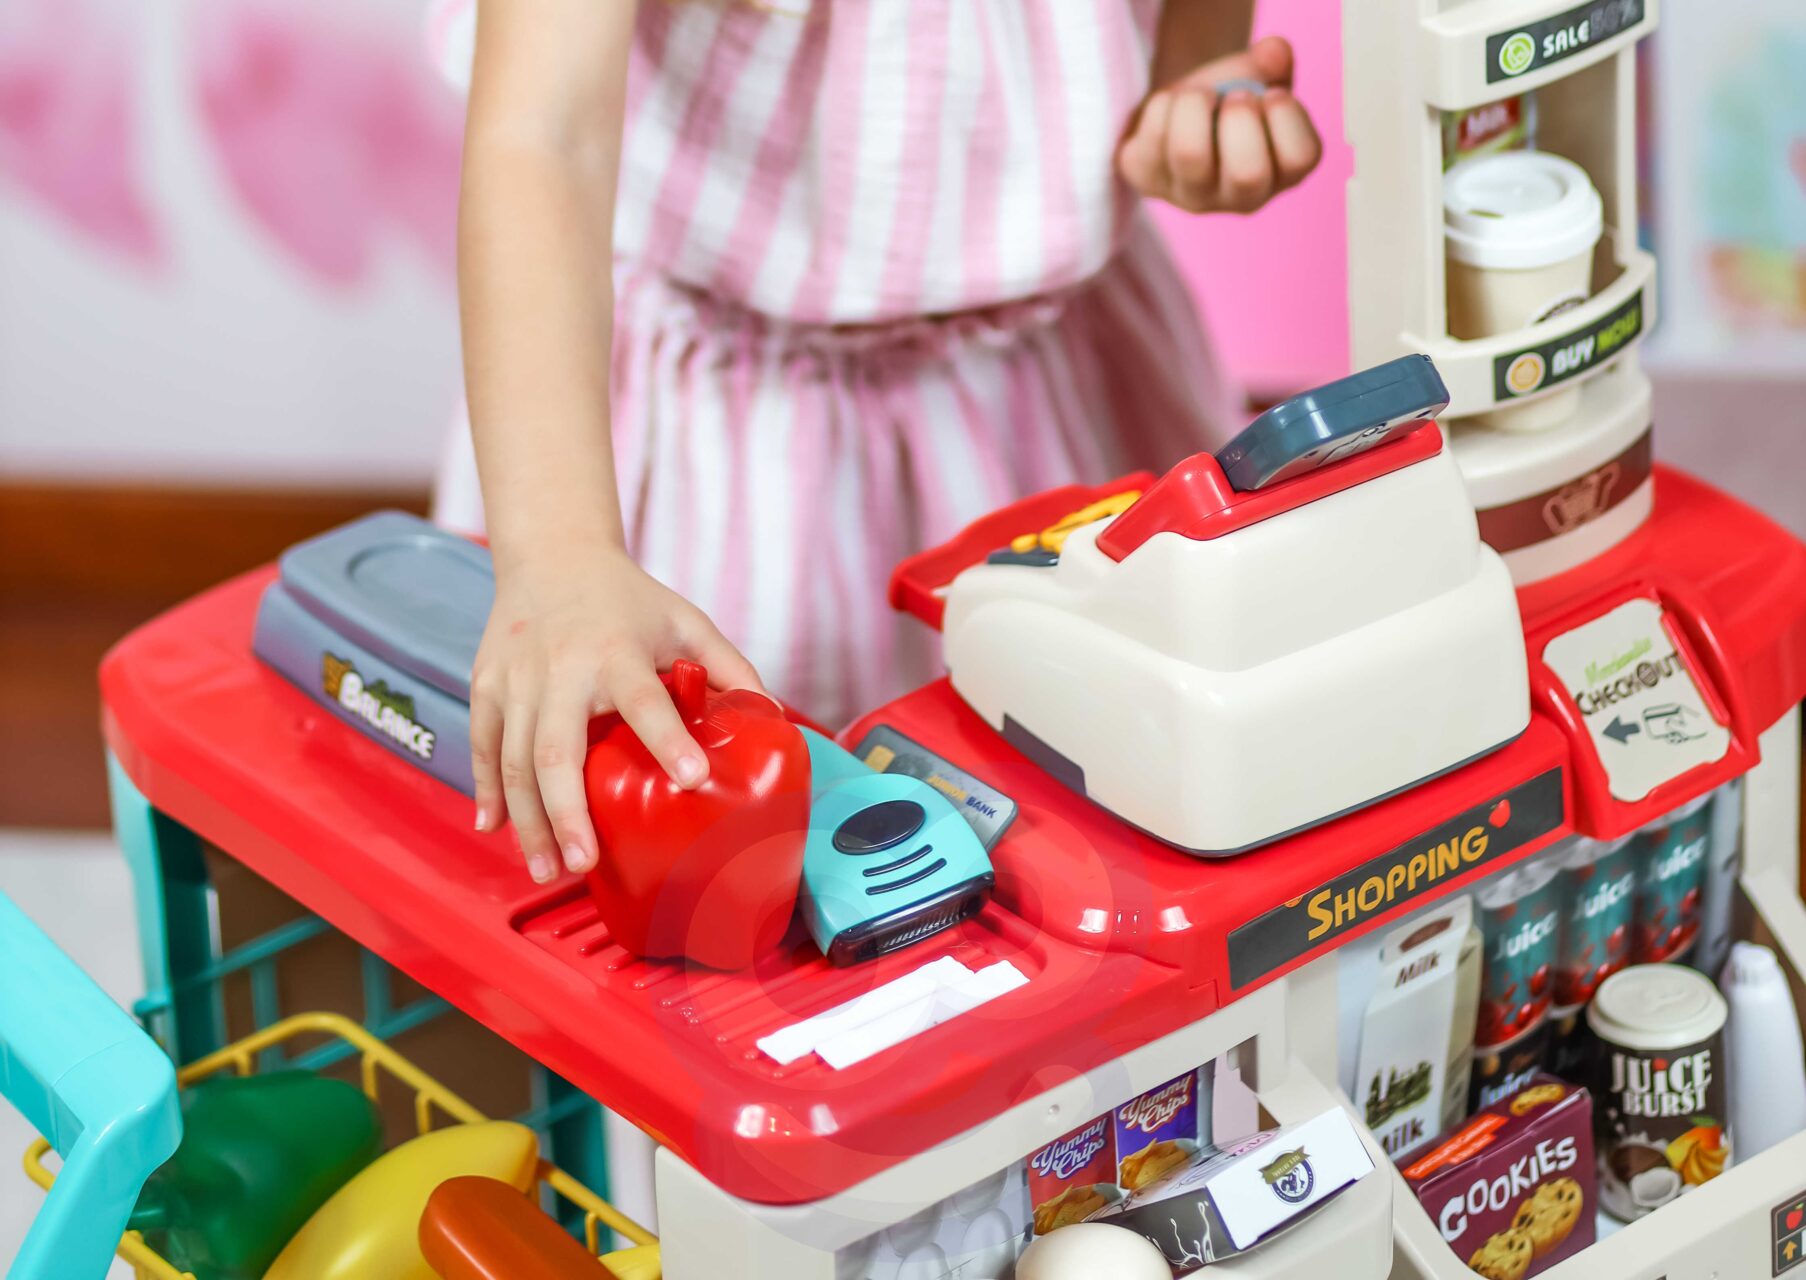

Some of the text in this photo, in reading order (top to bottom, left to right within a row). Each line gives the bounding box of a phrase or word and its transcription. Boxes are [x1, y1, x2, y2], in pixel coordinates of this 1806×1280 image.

[1543, 20, 1590, 58] SALE
[1552, 335, 1595, 376] BUY
[337, 671, 435, 760] BALANCE
[966, 796, 997, 818] BANK
[1308, 826, 1489, 940] SHOPPING
[1395, 949, 1441, 988] Milk
[1611, 1049, 1712, 1093] JUICE
[1118, 1074, 1193, 1129] Yummy
[1139, 1093, 1188, 1133] Chips
[1622, 1084, 1706, 1117] BURST
[1031, 1117, 1108, 1177] Yummy
[1052, 1138, 1105, 1179] Chips
[1440, 1136, 1577, 1242] COOKIES
